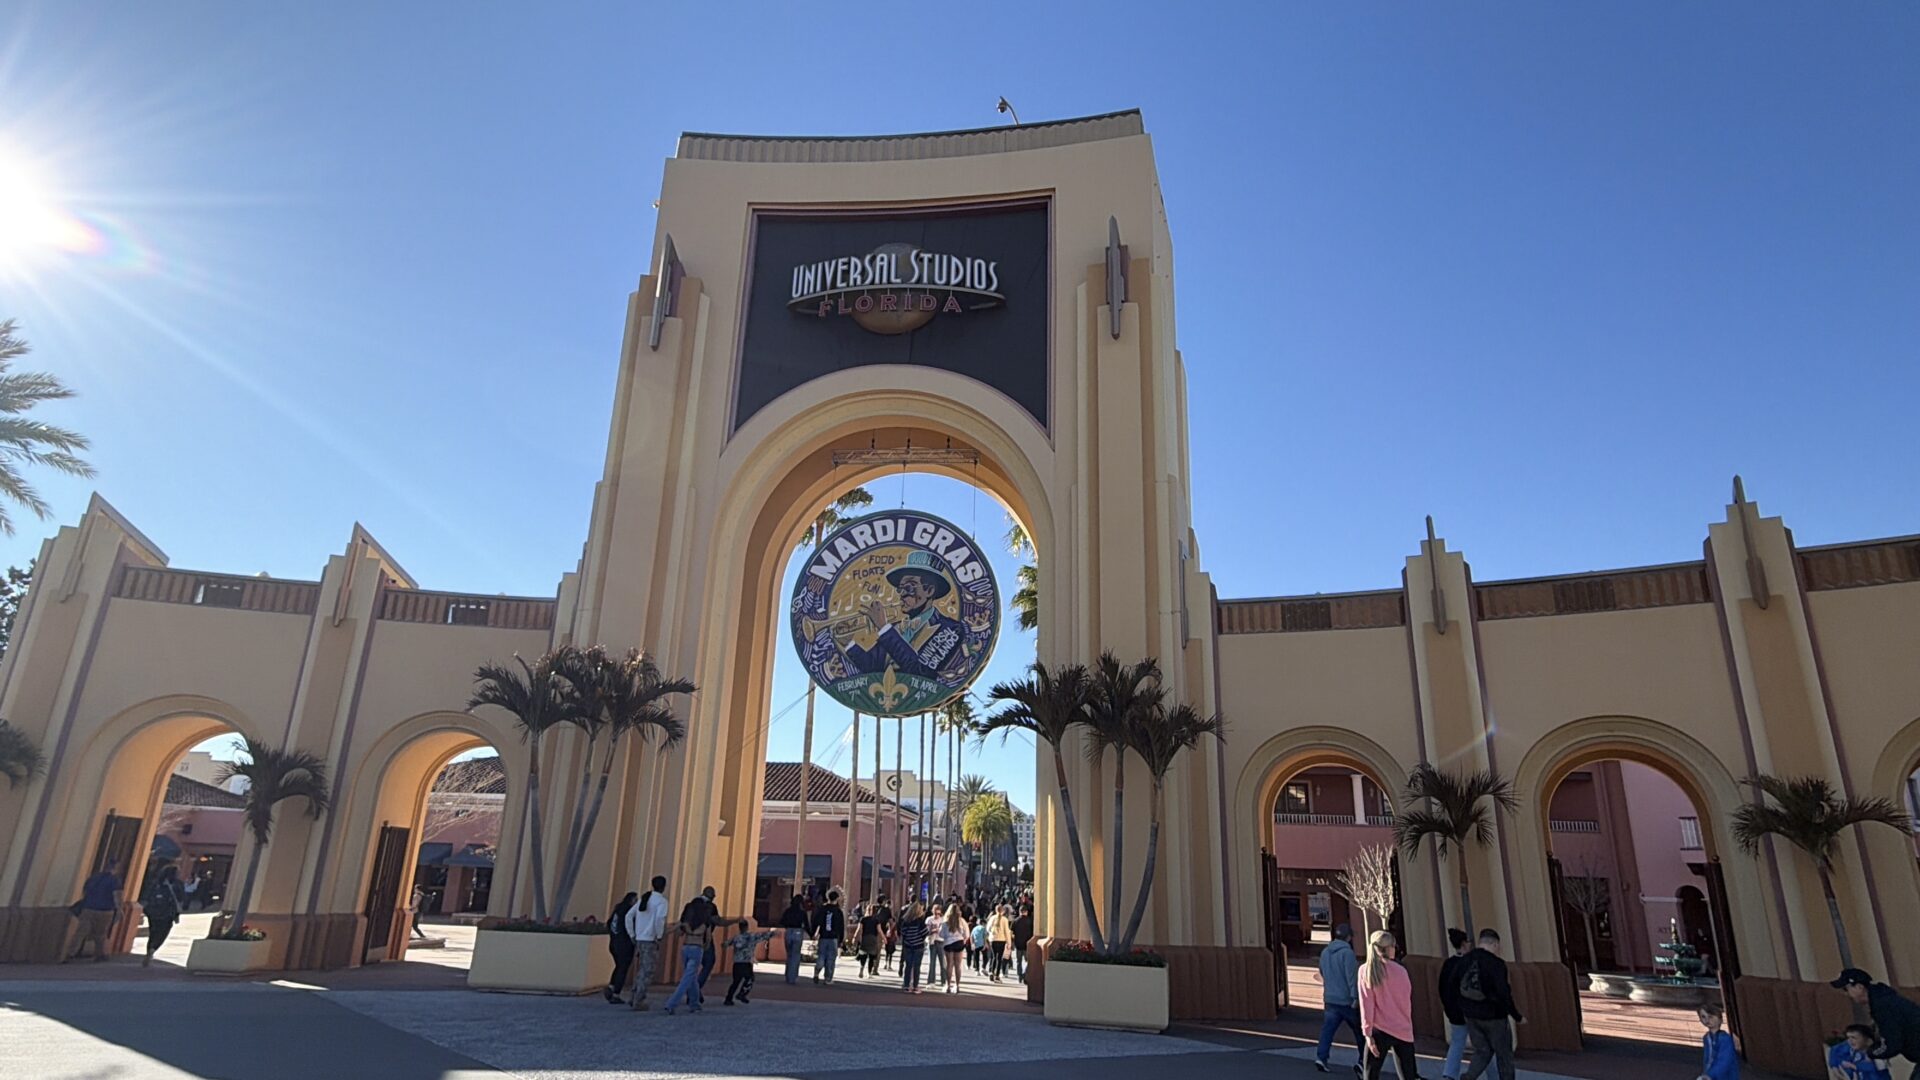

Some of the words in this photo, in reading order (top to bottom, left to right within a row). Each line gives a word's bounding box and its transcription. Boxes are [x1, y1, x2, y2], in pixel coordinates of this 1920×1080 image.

[791, 253, 901, 299] UNIVERSAL
[907, 249, 999, 292] STUDIOS
[818, 294, 963, 317] FLORIDA
[809, 518, 906, 581] MARDI
[912, 520, 985, 584] GRAS
[868, 554, 895, 565] FOOD
[852, 566, 886, 580] FLOATS
[862, 580, 881, 594] FUN
[918, 626, 956, 666] UNIVERSAL
[928, 633, 959, 670] ORLANDO
[837, 676, 868, 692] FEBRUARY
[920, 682, 938, 694] APRIL
